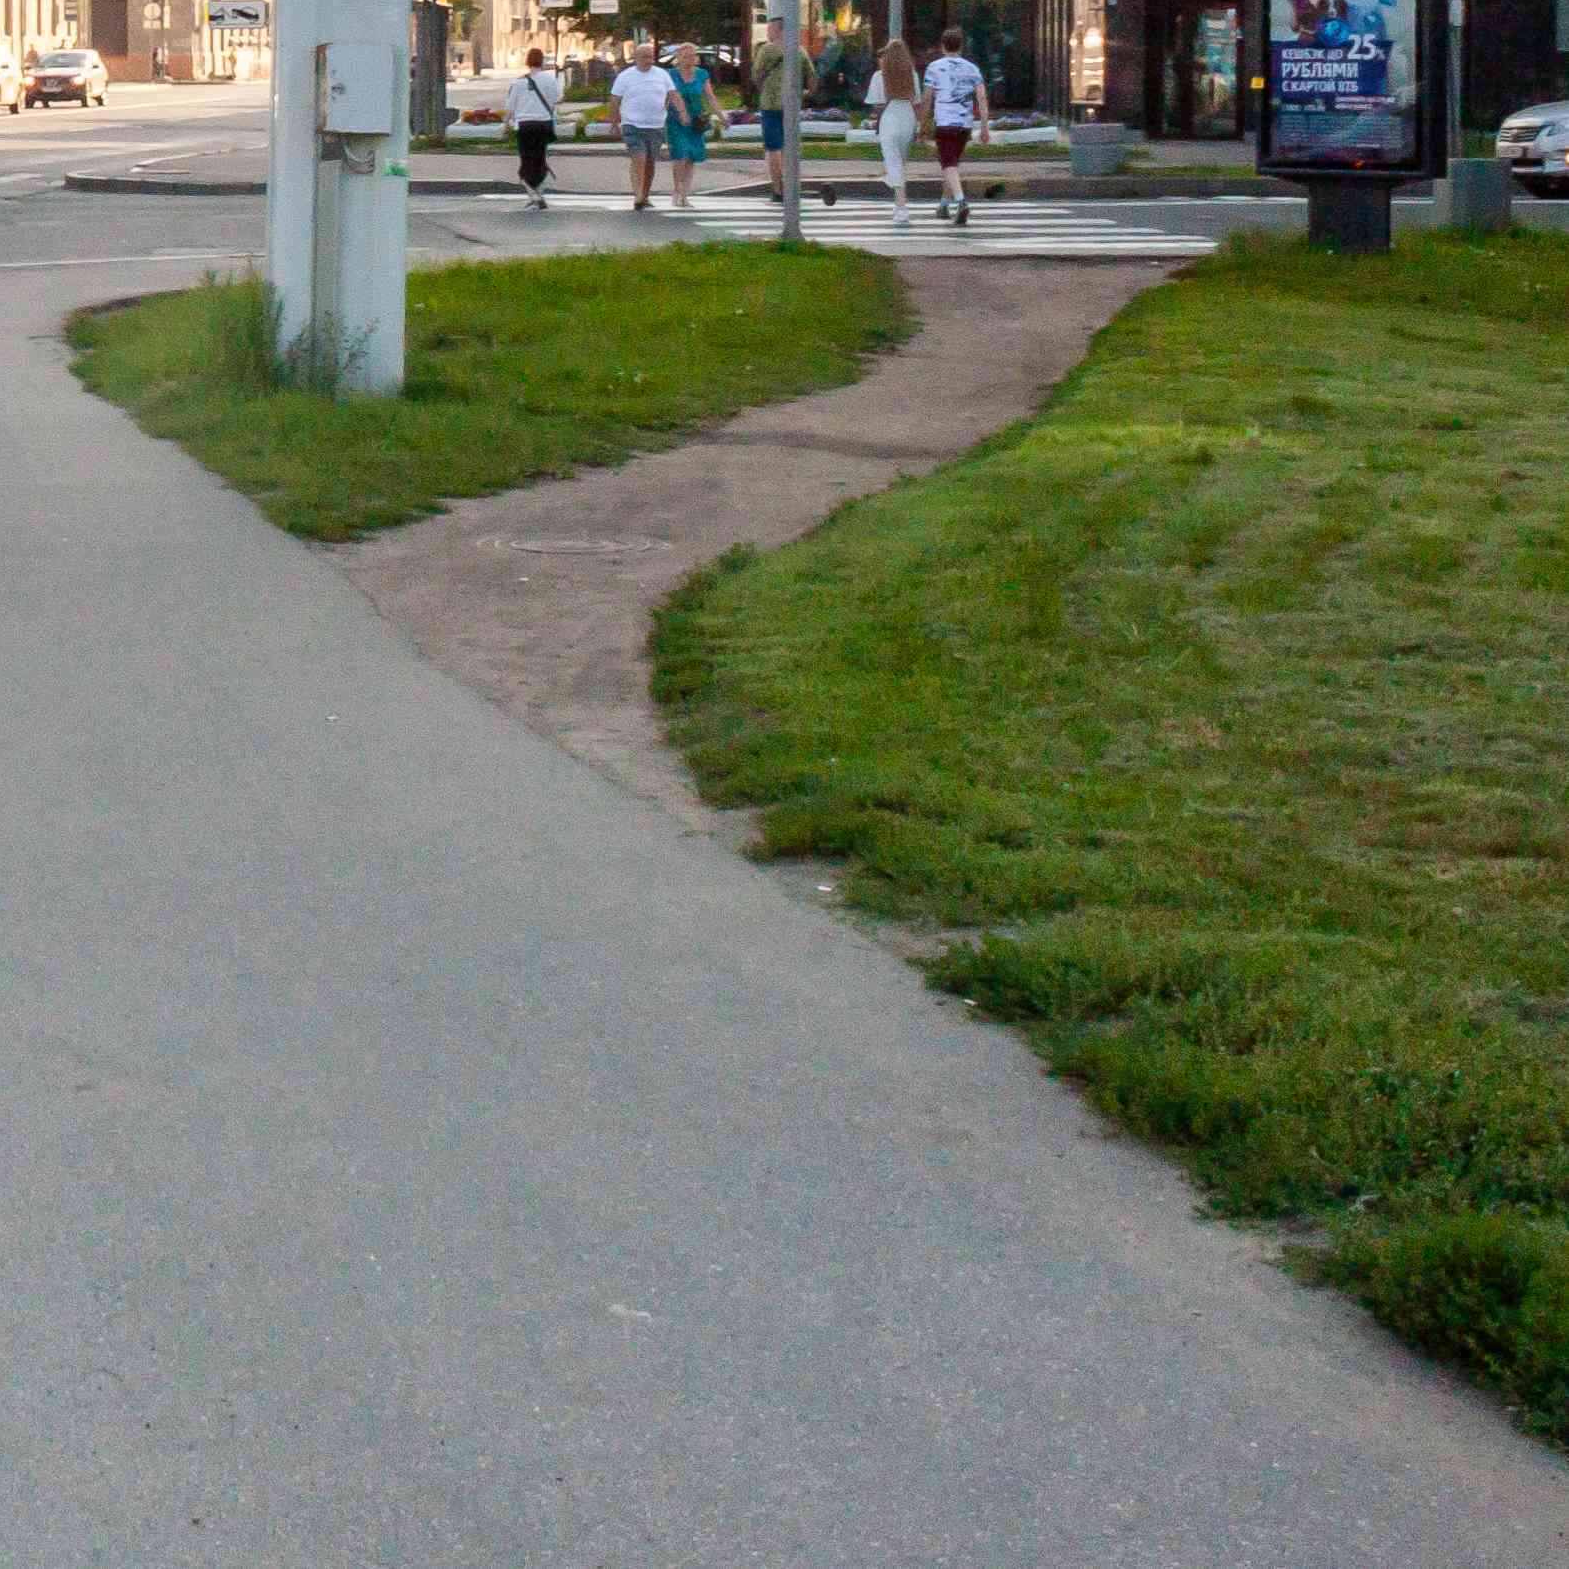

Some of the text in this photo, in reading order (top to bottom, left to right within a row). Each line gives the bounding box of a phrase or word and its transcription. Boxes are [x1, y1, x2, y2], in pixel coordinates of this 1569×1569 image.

[1281, 61, 1359, 79] РУБЛЯМИ
[1281, 77, 1359, 93] С КАРТОЙ ВТБ
